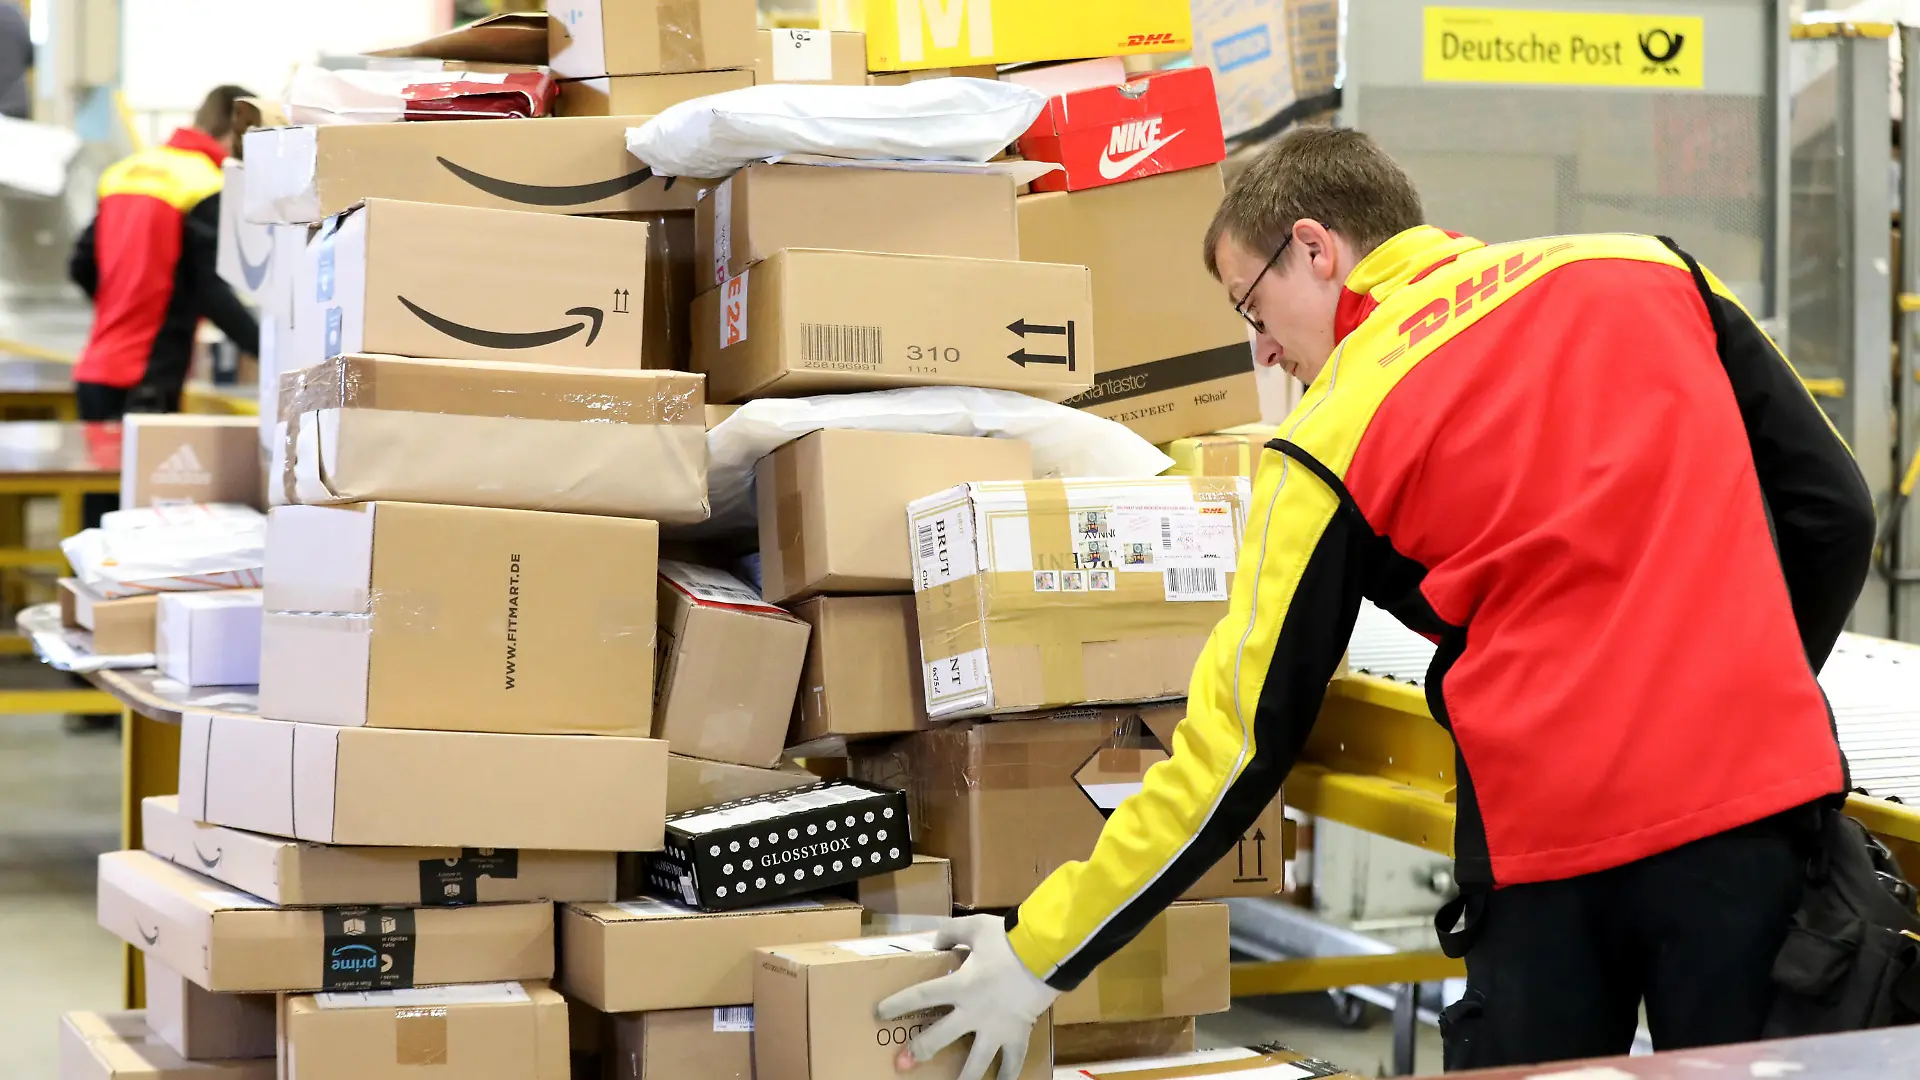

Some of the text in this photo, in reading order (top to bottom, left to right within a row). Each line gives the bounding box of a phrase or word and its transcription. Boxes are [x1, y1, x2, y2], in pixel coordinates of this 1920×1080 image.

[1127, 33, 1175, 46] DHL
[1442, 31, 1622, 65] Deutsche Post
[1109, 118, 1162, 155] NIKE
[1398, 252, 1543, 348] DHL
[906, 345, 960, 363] 310
[908, 366, 938, 374] 1114
[1120, 402, 1175, 421] EXPERT
[936, 519, 950, 576] BRUT
[505, 554, 520, 690] WWW.FITMART.DE
[761, 837, 851, 867] GLOSSYBOX
[332, 955, 377, 972] prime
